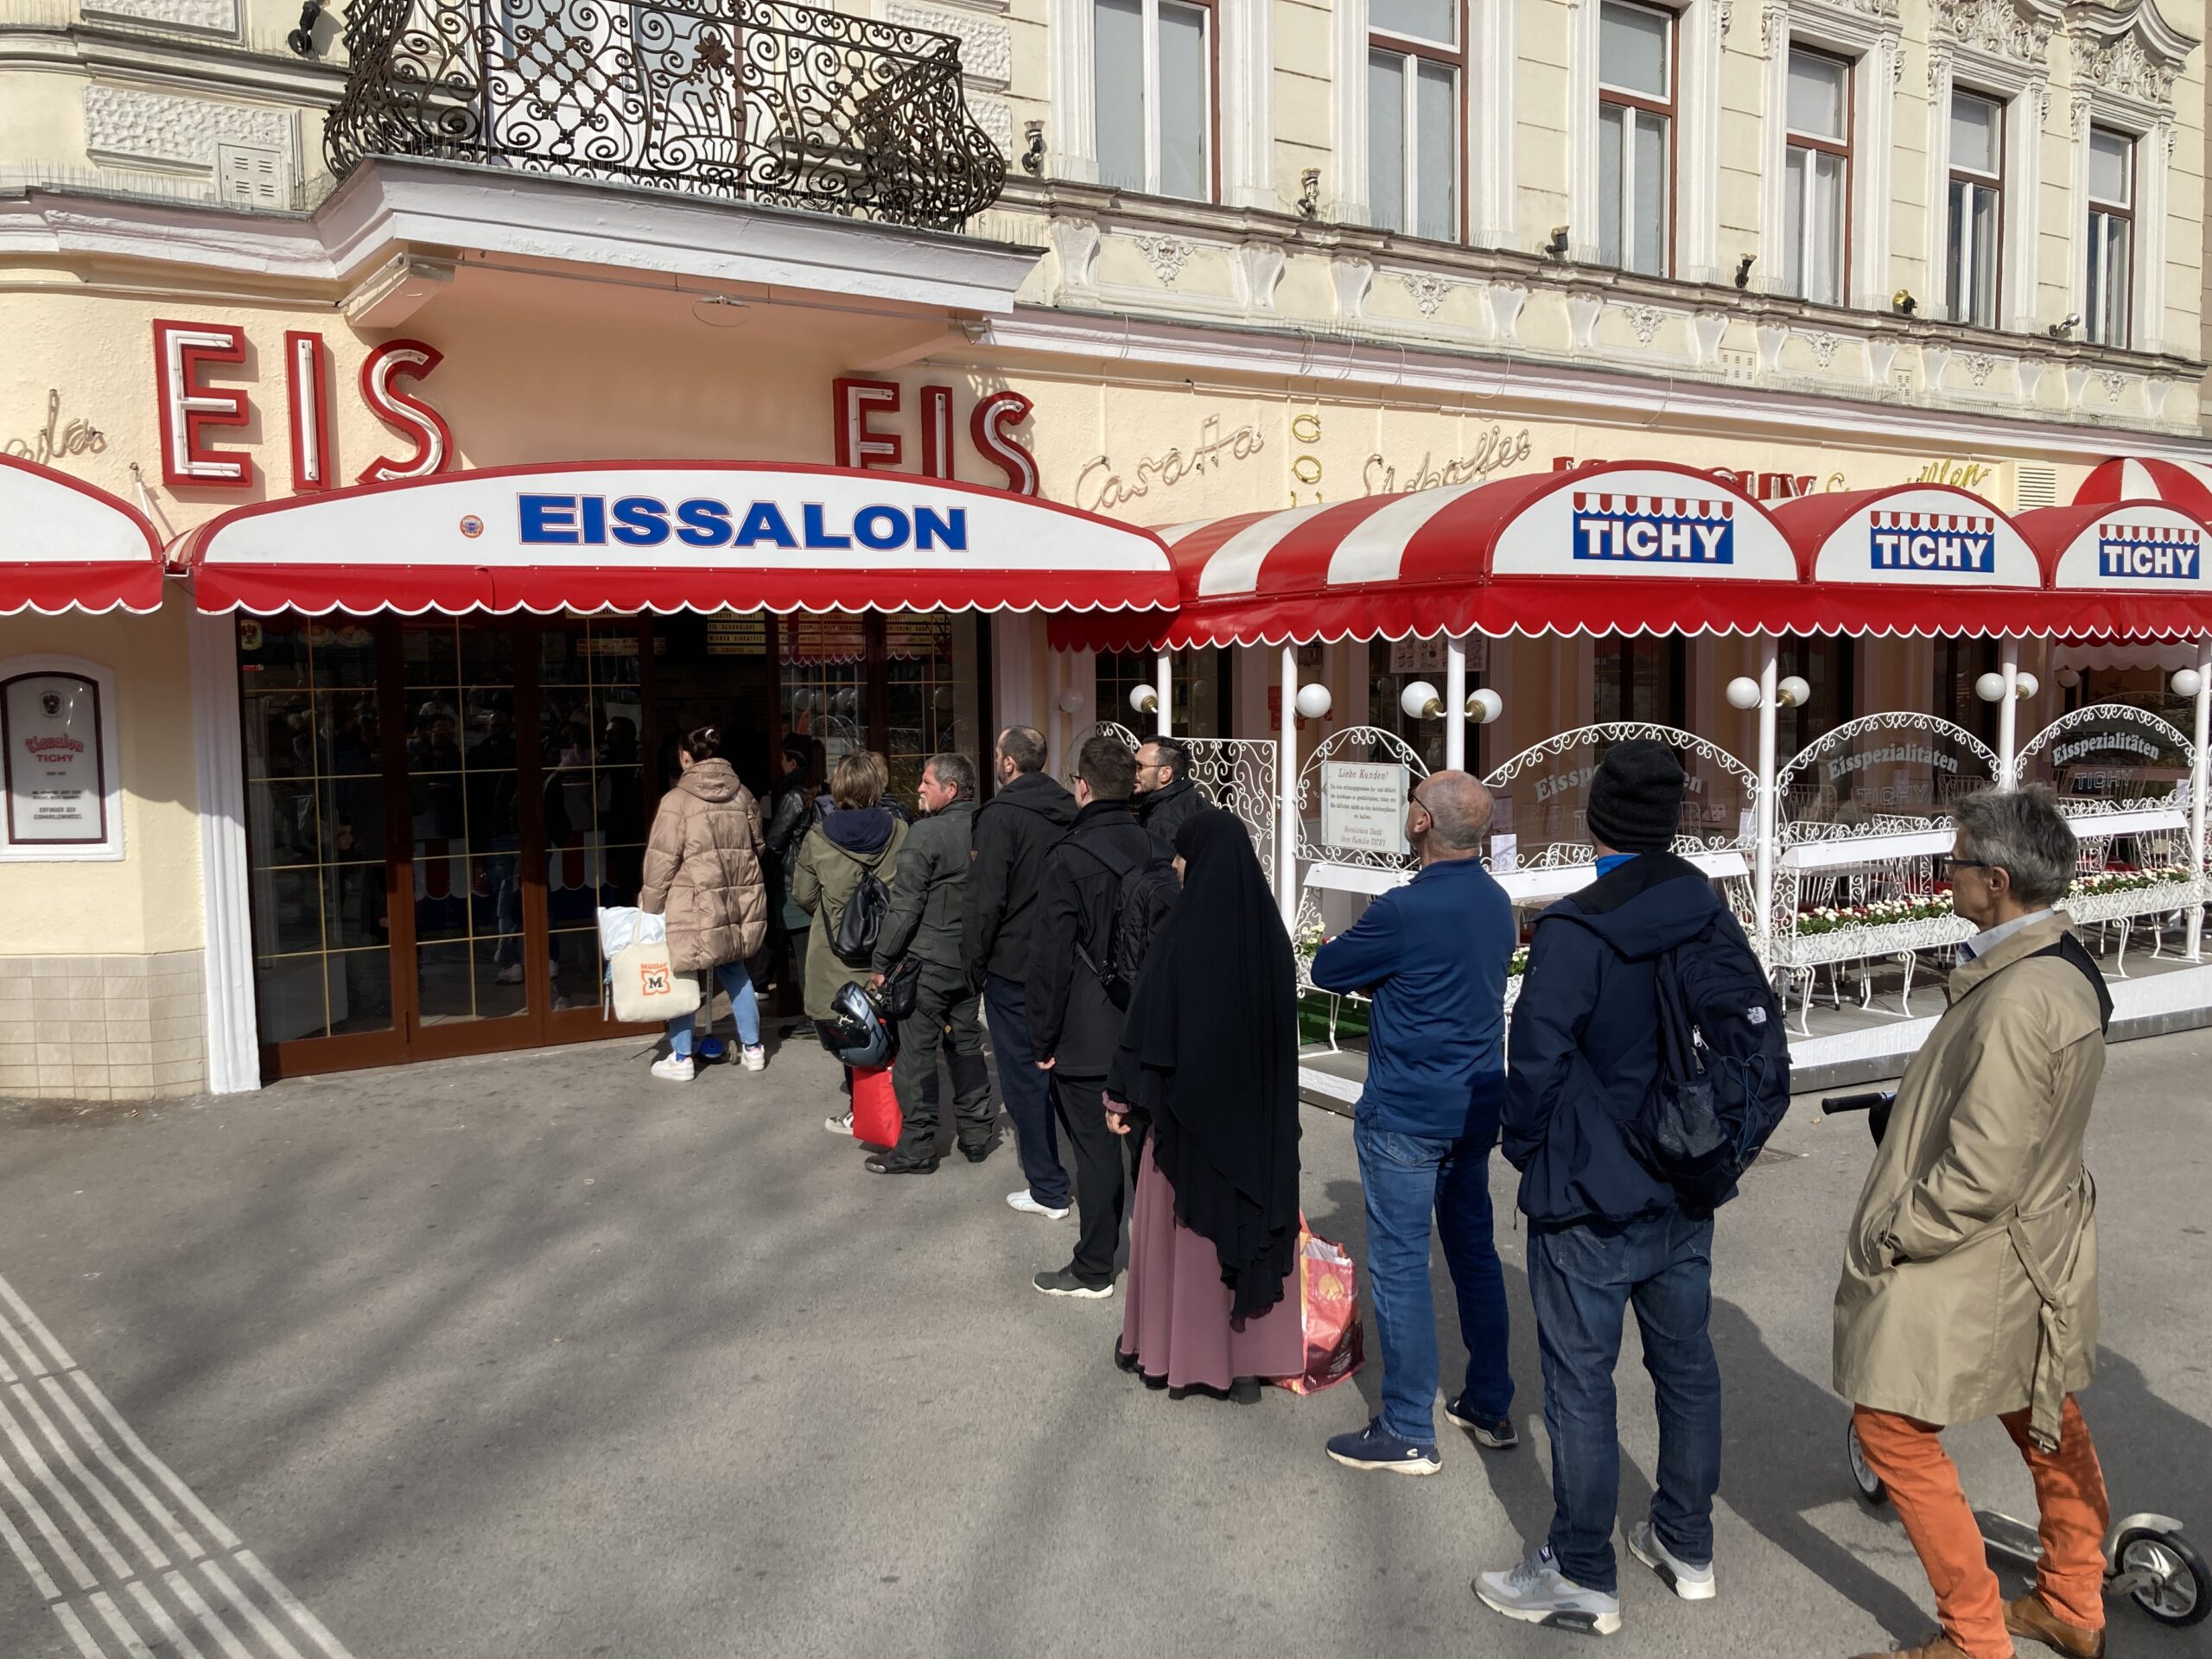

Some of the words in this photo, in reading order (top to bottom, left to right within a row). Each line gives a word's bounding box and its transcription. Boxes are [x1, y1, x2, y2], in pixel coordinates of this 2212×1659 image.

[153, 319, 453, 491] EIS
[832, 378, 1041, 497] EIS
[517, 493, 969, 553] EISSALON
[1580, 518, 1726, 559] TICHY
[1875, 534, 1988, 569] TICHY
[2103, 544, 2195, 575] TICHY
[35, 753, 74, 762] TICHY
[1827, 742, 1959, 781] Eisspezialitäten
[2052, 732, 2159, 766] Eisspezialitäten
[1338, 767, 1357, 779] Liebe
[1359, 768, 1389, 780] Kunden!
[2075, 769, 2133, 790] TICHY
[1859, 784, 1929, 807] TICHY
